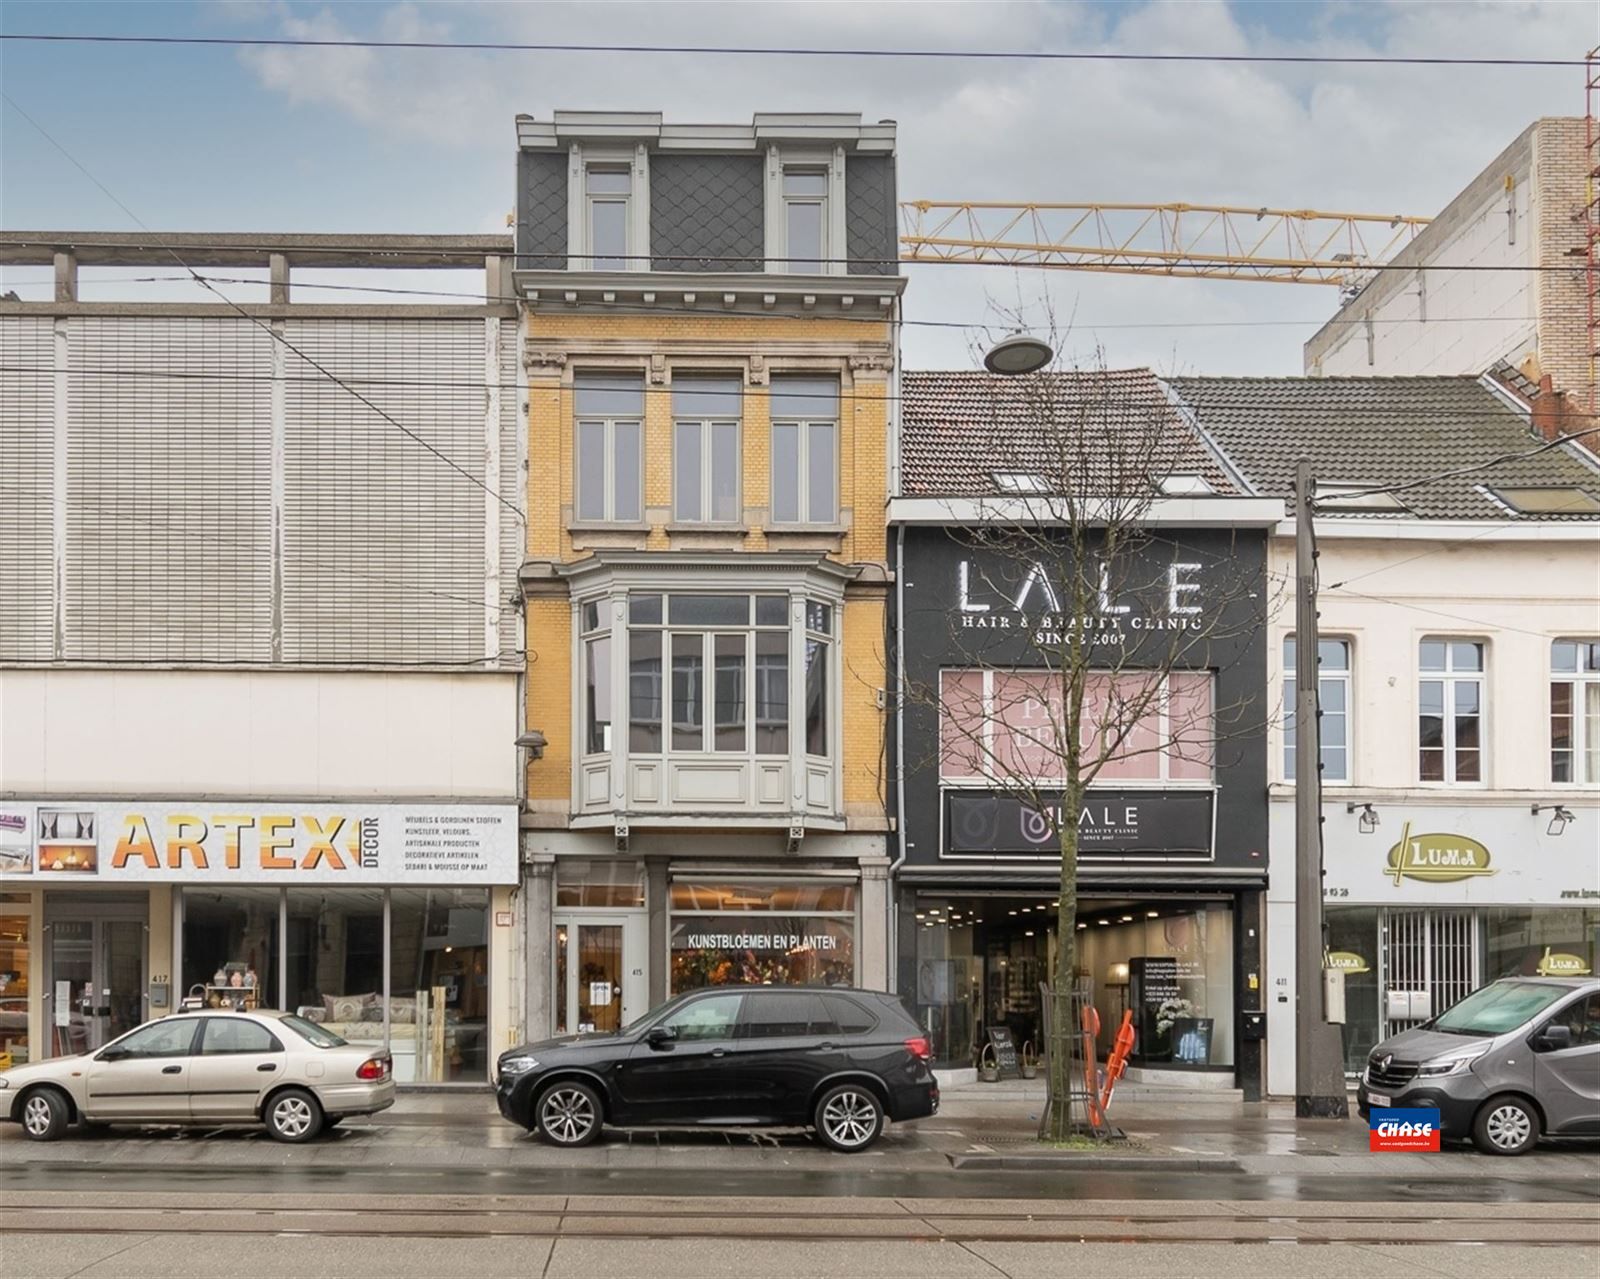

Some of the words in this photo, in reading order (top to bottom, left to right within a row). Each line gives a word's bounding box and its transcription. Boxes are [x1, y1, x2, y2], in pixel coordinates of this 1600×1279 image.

[959, 561, 1203, 613] LALE
[962, 616, 1011, 628] HAIR
[1020, 617, 1029, 628] &
[1041, 616, 1122, 629] BEAUTY
[1130, 617, 1203, 630] CLINIC
[1036, 632, 1086, 645] SINCE
[405, 816, 434, 824] MEUBELS
[434, 816, 439, 824] &
[476, 816, 502, 824] STOFFEN
[1057, 807, 1139, 825] LALE
[111, 815, 347, 869] ARTEX
[363, 816, 379, 869] DECOR
[443, 840, 480, 848] PRODUCTEN
[428, 863, 433, 871] &
[434, 863, 460, 871] MOUSSE
[461, 863, 470, 871] OP
[471, 863, 488, 871] MAAT
[688, 934, 771, 949] KUNSTBLOEMEN
[773, 934, 788, 949] EN
[789, 935, 836, 949] PLANTEN
[152, 974, 169, 983] 417
